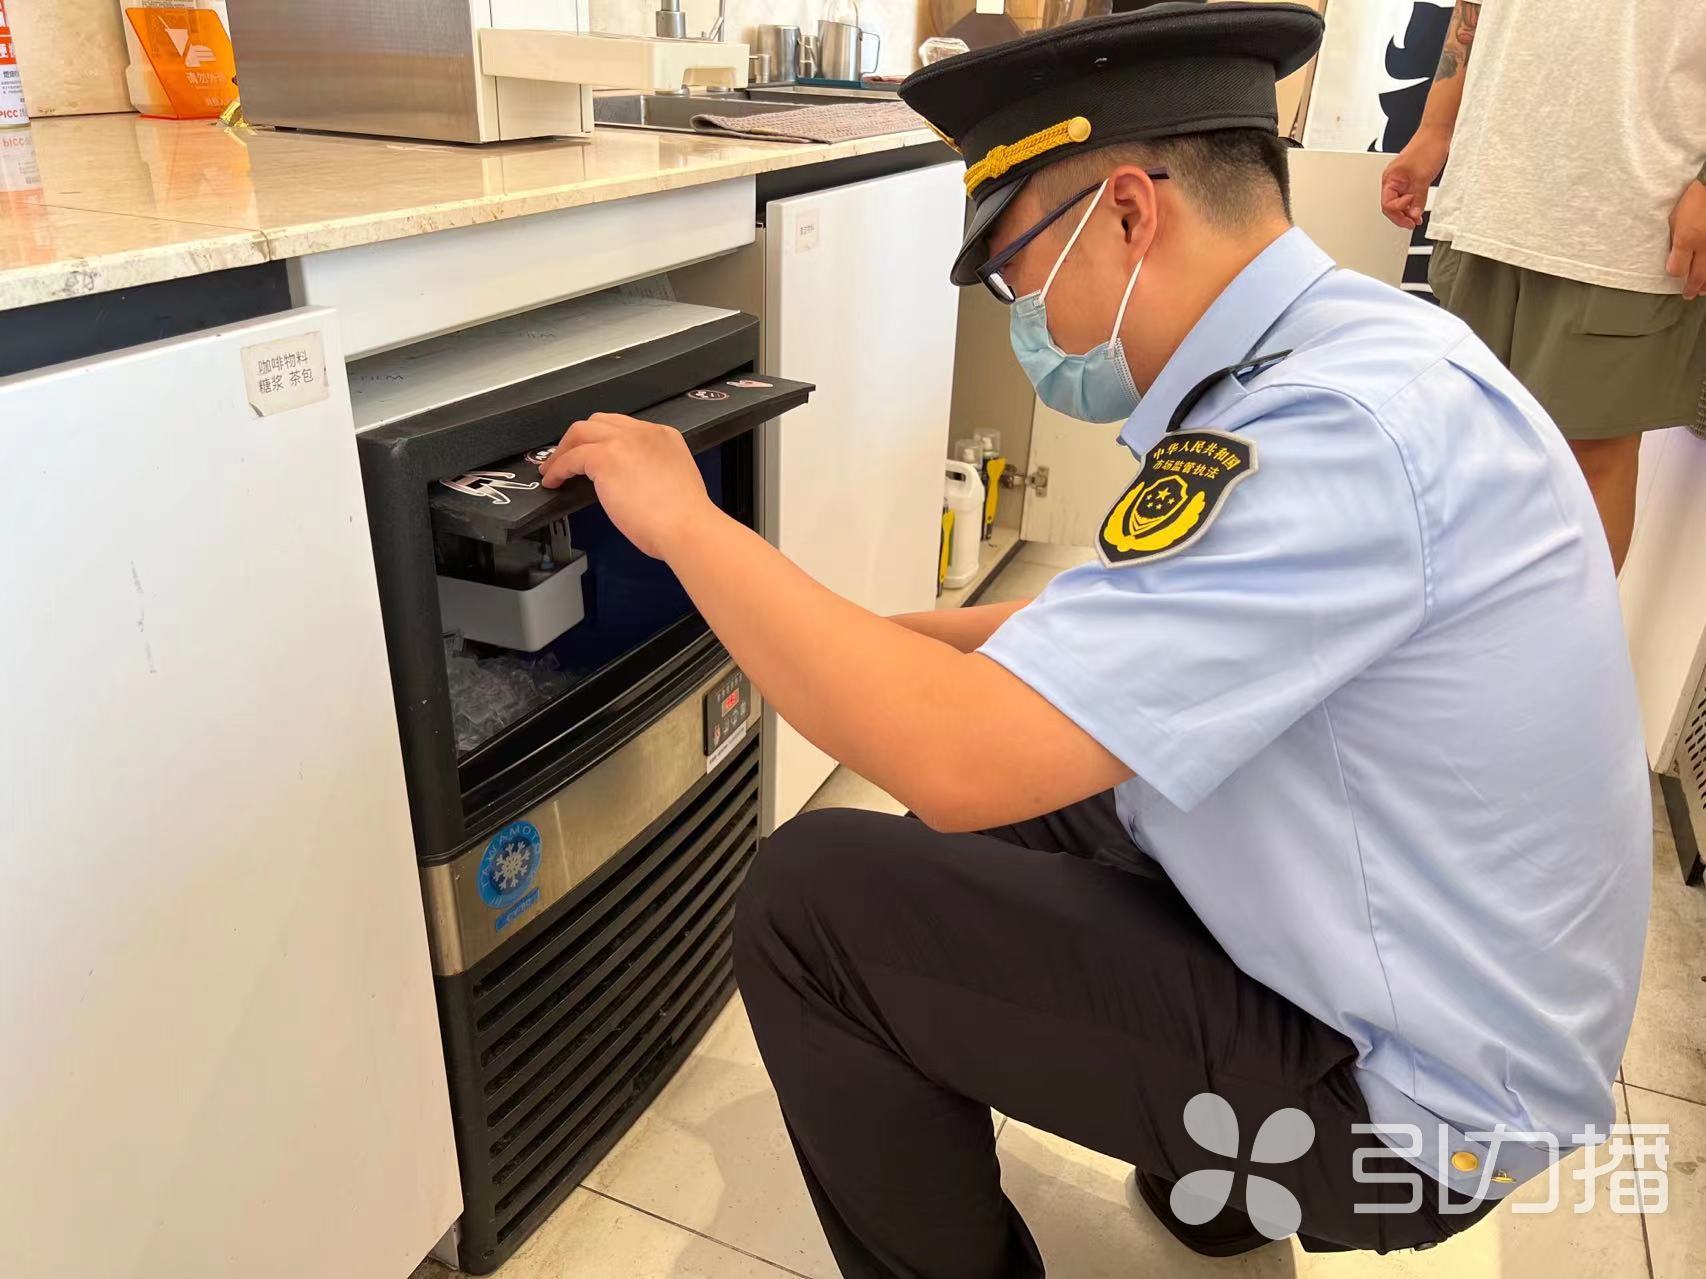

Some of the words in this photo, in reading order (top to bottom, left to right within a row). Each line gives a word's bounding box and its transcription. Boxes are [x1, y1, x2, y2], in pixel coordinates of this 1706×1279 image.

[258, 349, 308, 375] 咖啡物料
[258, 375, 284, 394] 糖浆
[289, 368, 314, 386] 茶包
[1153, 440, 1241, 471] 中华人民共和国
[1153, 459, 1220, 480] 市场监管执法
